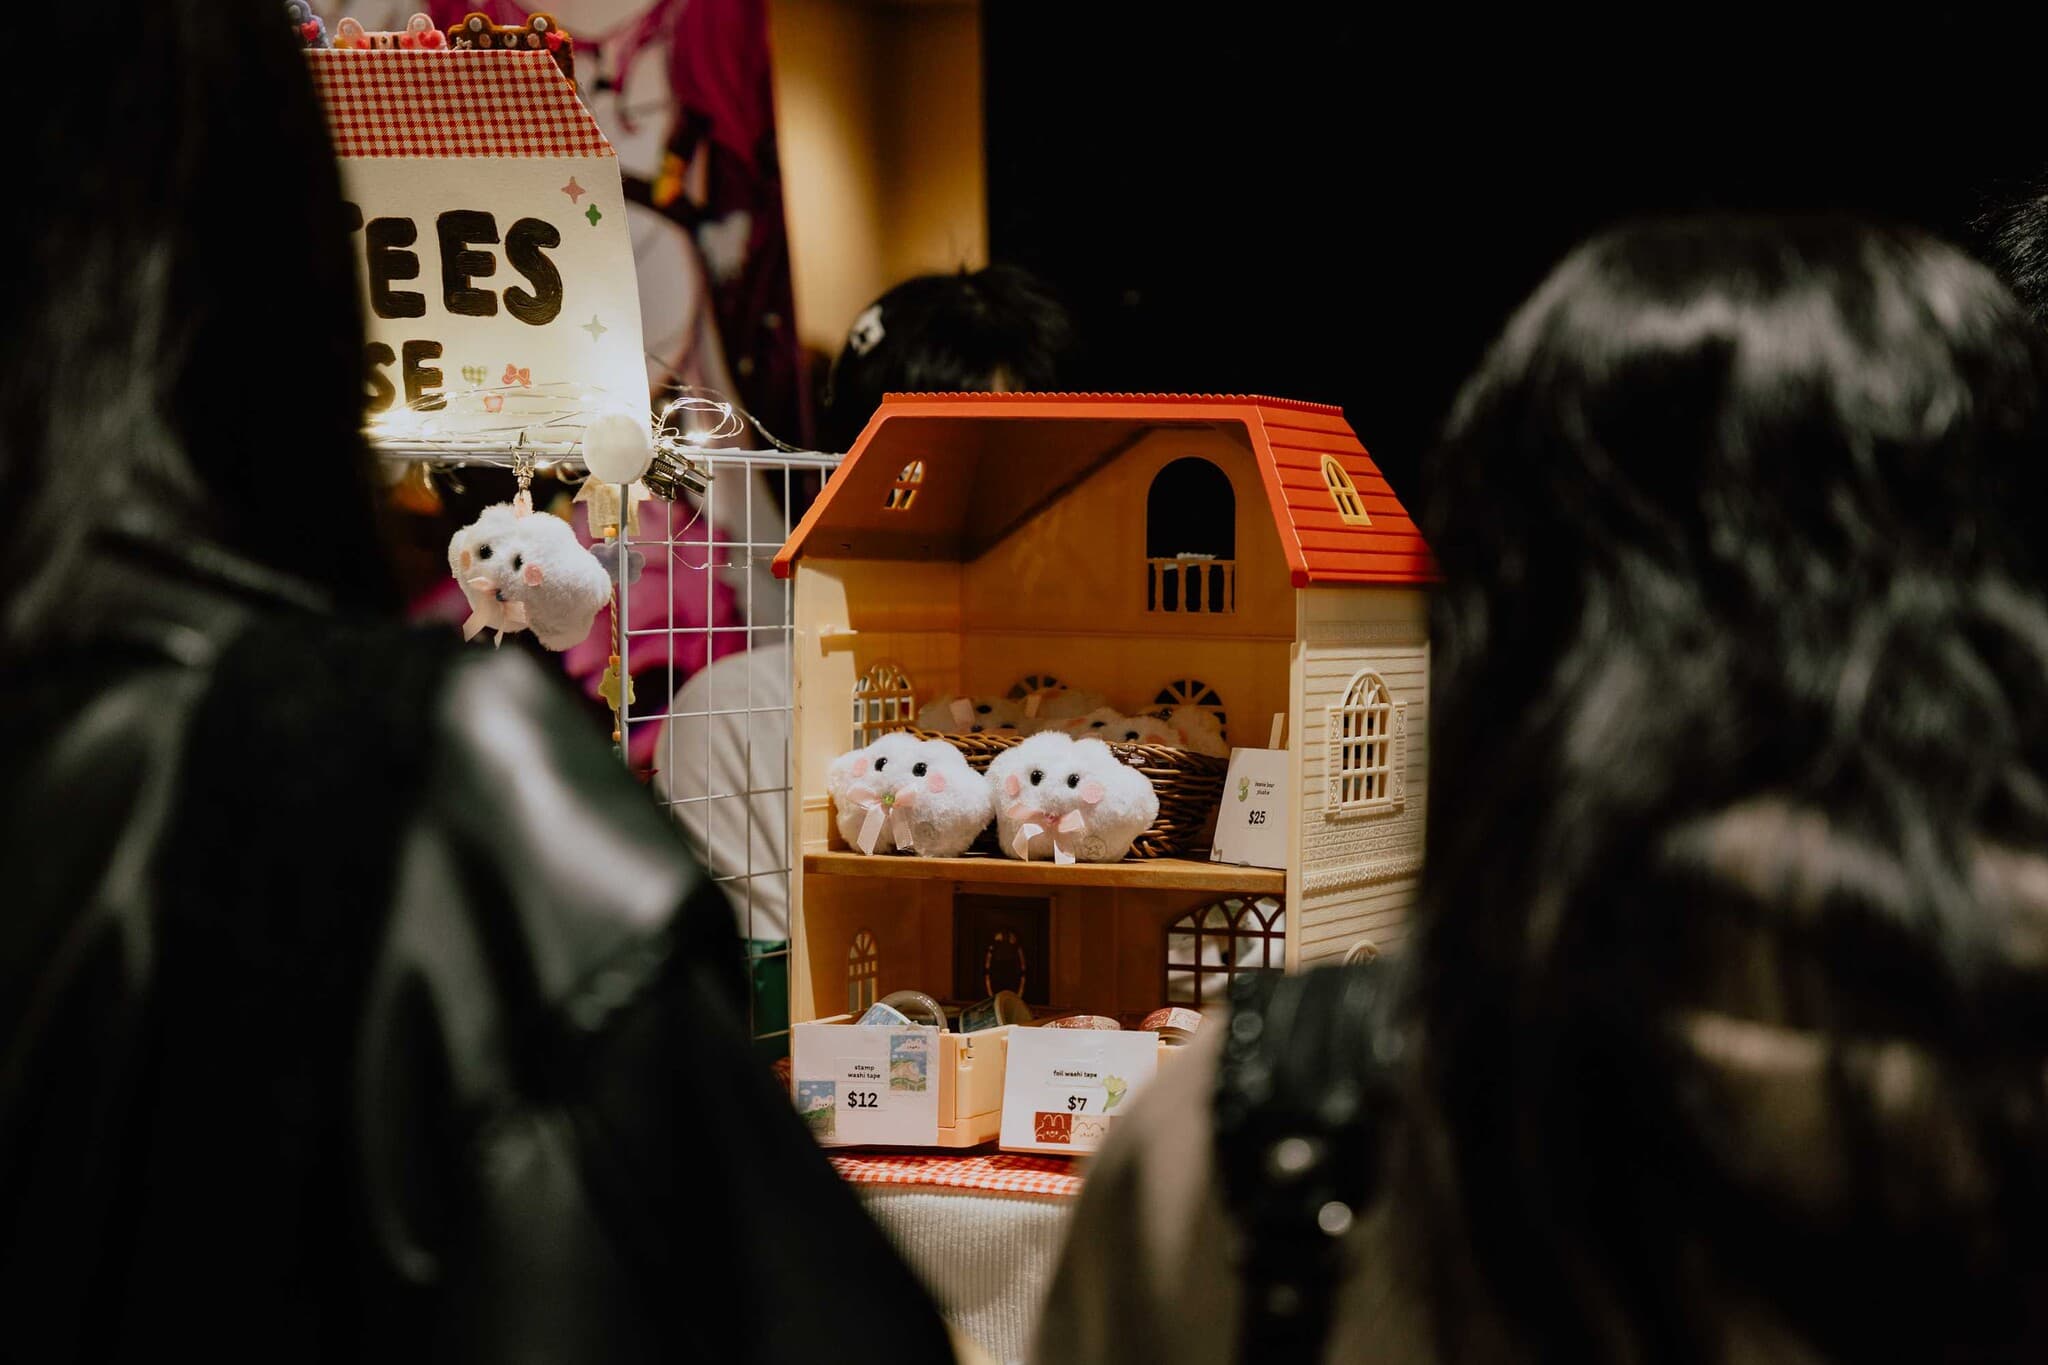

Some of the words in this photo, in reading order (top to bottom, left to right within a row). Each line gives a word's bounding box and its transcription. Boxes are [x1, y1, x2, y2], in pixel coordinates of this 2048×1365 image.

[340, 201, 562, 325] EES
[1248, 810, 1266, 825] $25
[854, 1064, 875, 1072] stamp
[1084, 1071, 1098, 1079] tape
[867, 1072, 881, 1080] tape
[848, 1090, 879, 1109] $12
[1067, 1095, 1088, 1111] $7
